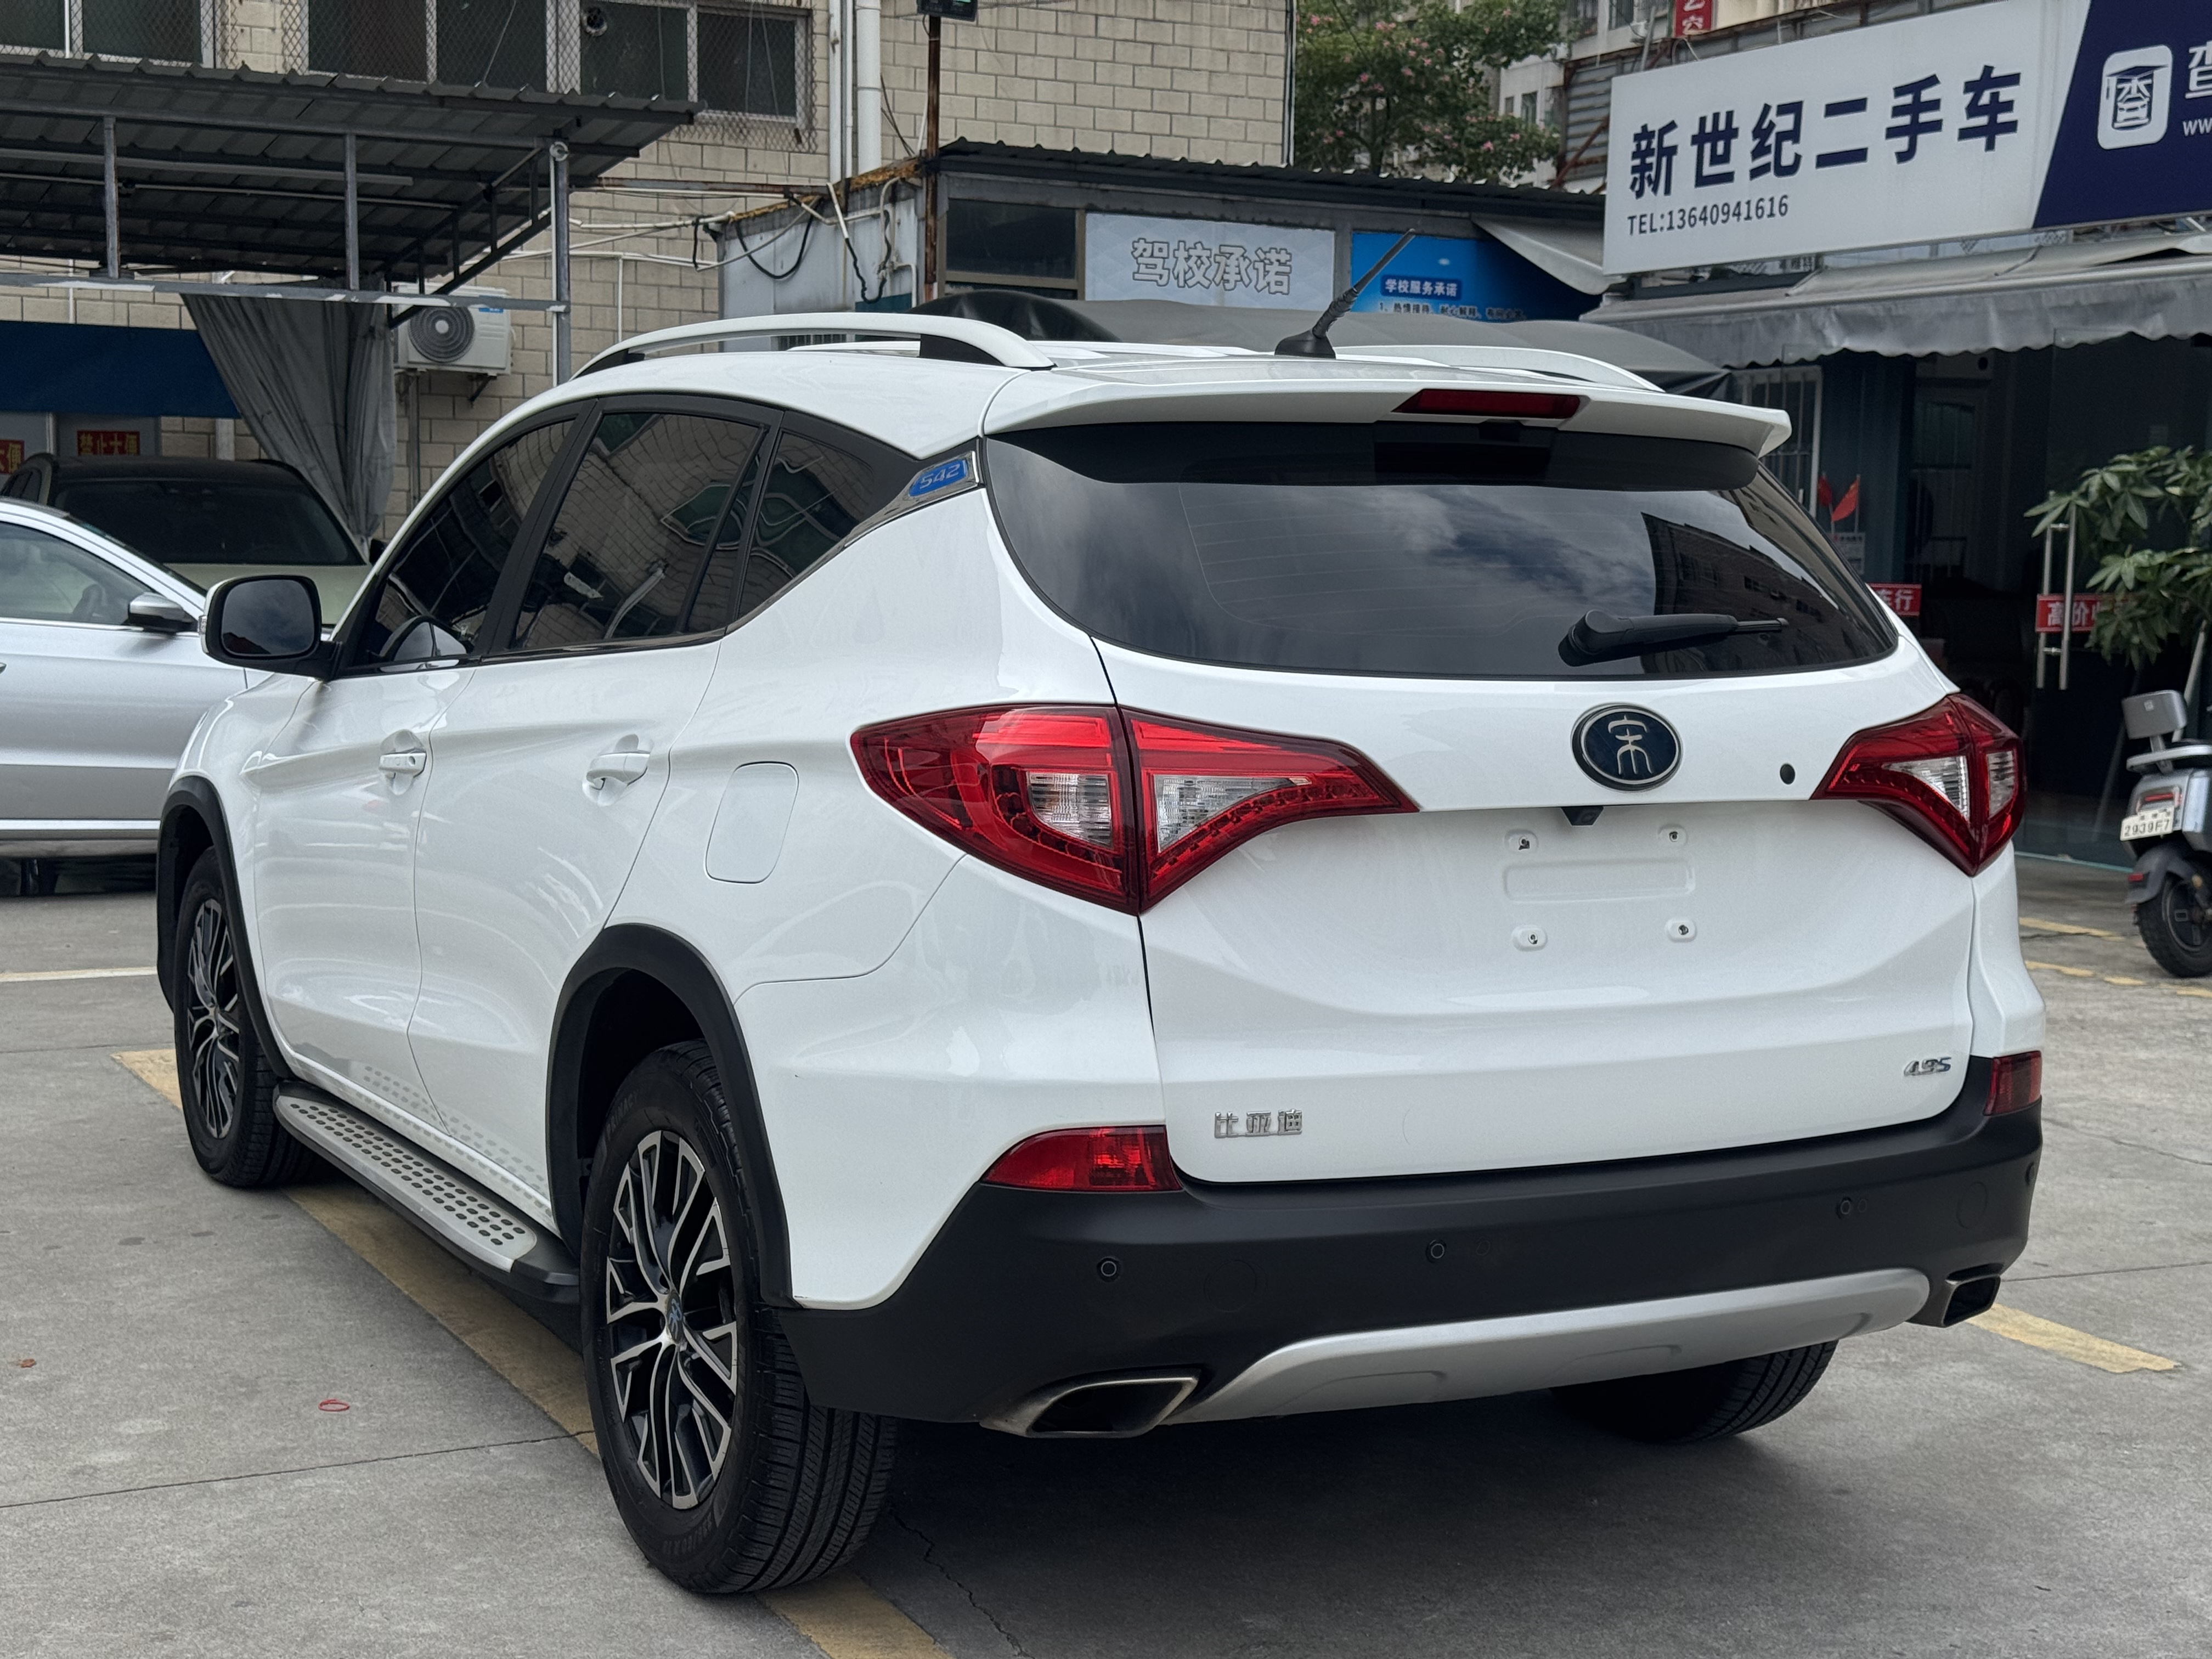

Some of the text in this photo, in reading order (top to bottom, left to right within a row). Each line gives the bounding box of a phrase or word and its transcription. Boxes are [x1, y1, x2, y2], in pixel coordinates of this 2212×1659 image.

[1629, 65, 2021, 200] 新世纪二手车
[1627, 194, 1789, 236] TEL:13640941616
[1131, 238, 1293, 295] 驾校承诺
[1385, 278, 1458, 297] 学校服务承诺
[919, 463, 961, 490] 542
[1214, 1108, 1302, 1139] 比亚迪
